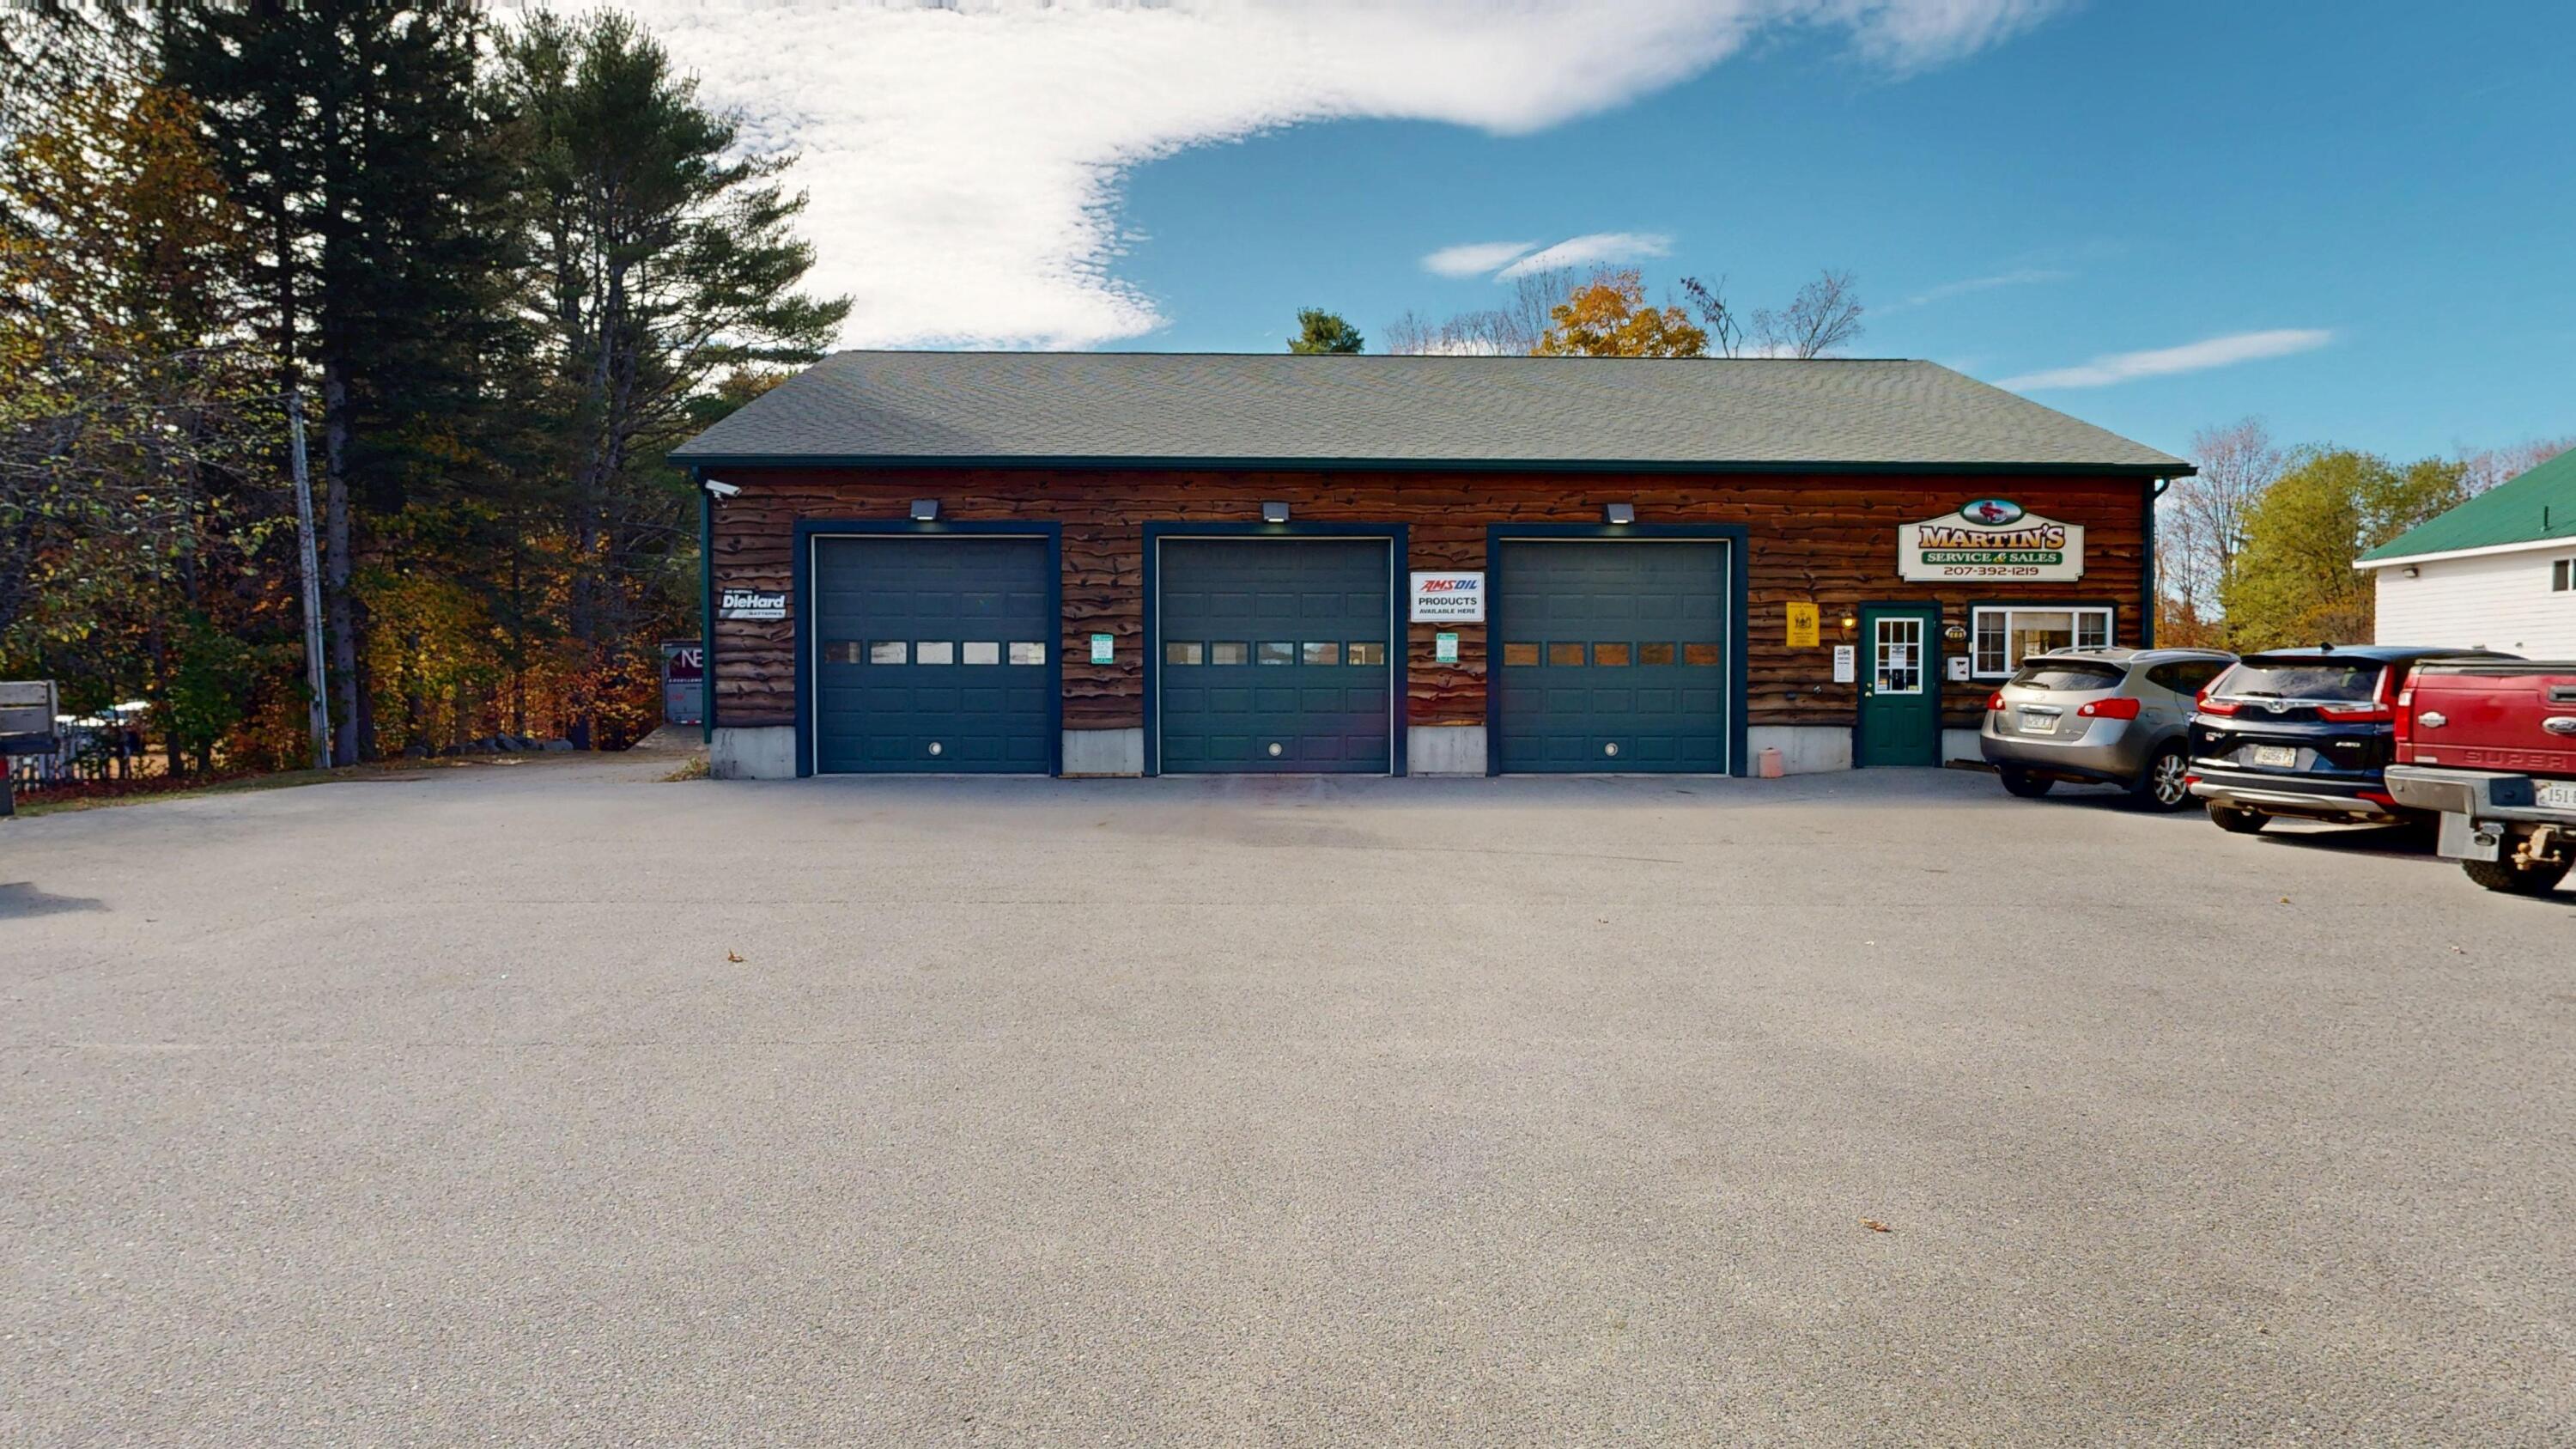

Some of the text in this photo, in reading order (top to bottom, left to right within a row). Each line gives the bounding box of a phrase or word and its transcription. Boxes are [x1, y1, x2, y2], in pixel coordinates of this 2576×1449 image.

[1919, 522, 2065, 550] MARTIN'S
[1927, 551, 2057, 563] SERVICE & SALES
[1943, 566, 2039, 576] 207-392-1219
[1419, 579, 1477, 593] AMSOIL
[722, 594, 786, 608] DieHard
[1419, 597, 1477, 606] PRODUCTS
[2464, 751, 2568, 769] SUPER
